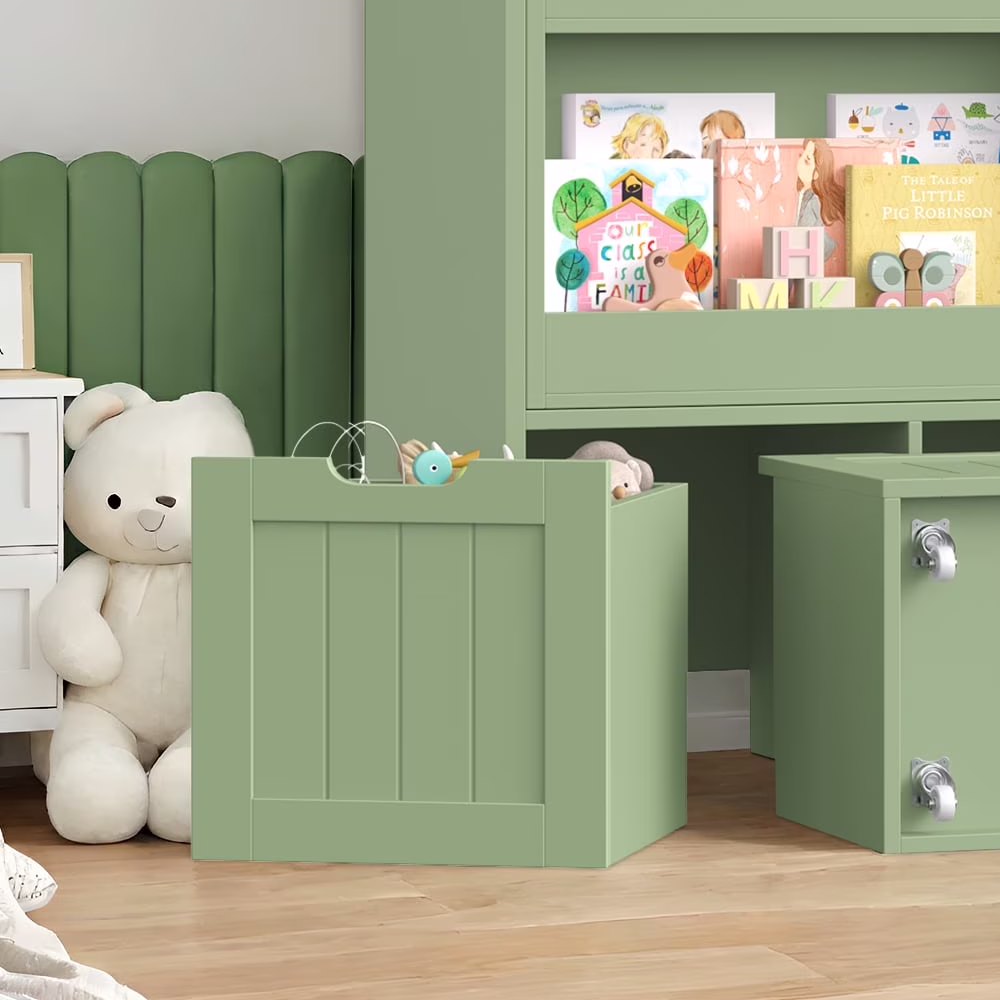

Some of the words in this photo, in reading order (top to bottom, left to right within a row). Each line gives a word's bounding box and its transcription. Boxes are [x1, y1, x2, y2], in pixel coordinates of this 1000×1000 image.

[901, 175, 927, 185] THE
[929, 175, 958, 185] TALE
[959, 176, 976, 184] OF
[910, 189, 965, 203] LITTLE
[882, 206, 910, 220] PIG
[914, 205, 993, 219] ROBINSON
[601, 240, 655, 261] class
[778, 229, 818, 277] H
[614, 267, 628, 280] is
[633, 266, 645, 281] a
[738, 281, 788, 310] M
